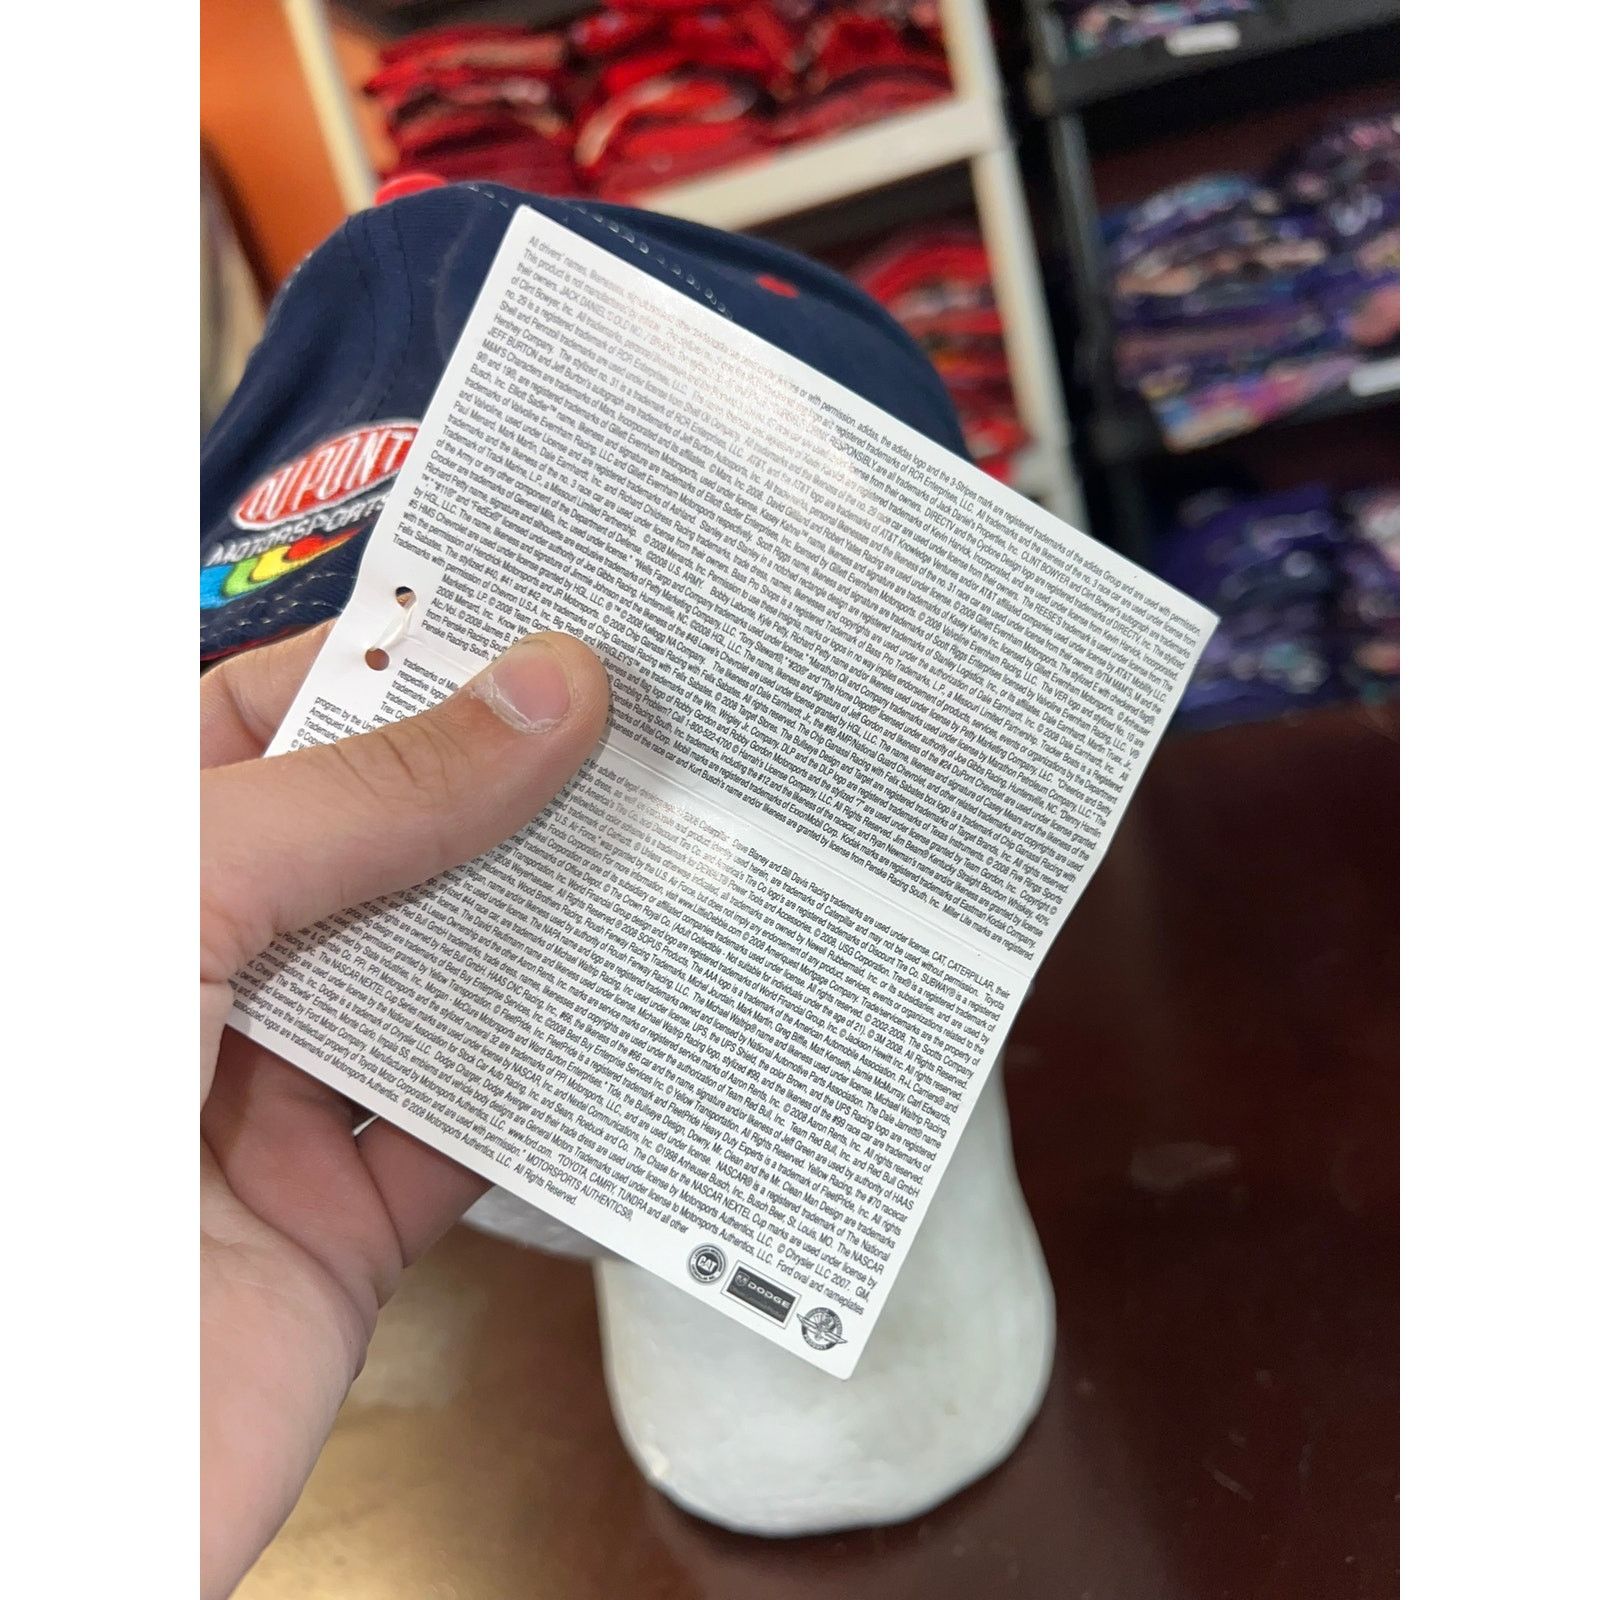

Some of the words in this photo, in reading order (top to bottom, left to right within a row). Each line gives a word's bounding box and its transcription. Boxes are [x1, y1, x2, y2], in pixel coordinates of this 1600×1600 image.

[486, 325, 508, 341] JEFF
[505, 334, 539, 359] BURTON
[536, 353, 553, 367] and
[549, 360, 566, 374] Jeff
[563, 366, 592, 389] Burton's
[590, 383, 625, 407] autograph
[623, 401, 637, 414] are
[635, 406, 673, 434] trademarks
[671, 428, 682, 438] of
[442, 423, 478, 451] Trademark
[476, 444, 487, 455] of
[485, 446, 504, 465] Track
[542, 480, 550, 490] a
[548, 481, 578, 504] Missouri
[575, 496, 602, 517] Limited
[407, 498, 419, 509] #5
[417, 501, 437, 518] HMS
[434, 511, 469, 535] Chevrolet
[466, 529, 480, 541] are
[478, 535, 498, 550] used
[495, 544, 516, 559] under
[392, 532, 431, 560] Trademarks
[430, 554, 446, 567] with
[444, 562, 482, 586] permission
[480, 580, 492, 589] of
[489, 582, 518, 604] Chevron
[1081, 559, 1104, 577] adidas
[1102, 569, 1122, 588] Group
[1120, 582, 1135, 595] and
[1131, 589, 1144, 601] are
[1142, 596, 1160, 610] used
[1157, 604, 1171, 617] with
[425, 607, 442, 623] from
[440, 615, 467, 635] Penske
[465, 627, 490, 648] Racing
[494, 599, 514, 615] 2008
[512, 607, 532, 625] Team
[1020, 549, 1042, 568] CLINT
[1039, 561, 1071, 586] BOWYER
[1067, 580, 1083, 593] and
[1079, 586, 1096, 601] Clint
[1093, 593, 1121, 617] Bowyer's
[1119, 611, 1150, 634] autograph
[1147, 629, 1160, 640] are
[1158, 633, 1191, 659] trademarks
[420, 618, 446, 639] Penske
[444, 630, 470, 652] Racing
[612, 677, 643, 702] Gambling
[641, 693, 673, 717] Problem?
[670, 710, 686, 724] Call
[684, 718, 733, 750] 1-800-522-4700
[737, 747, 765, 768] Harrah's
[762, 761, 789, 781] License
[921, 720, 941, 735] used
[937, 729, 959, 745] under
[955, 737, 980, 757] license
[977, 749, 988, 762] by
[985, 754, 1018, 778] Marathon
[1015, 770, 1049, 795] Petroleum
[937, 757, 953, 771] #24
[949, 763, 976, 784] DuPont
[973, 777, 1006, 801] Chevrolet
[1002, 795, 1016, 806] are
[1014, 801, 1034, 815] used
[1030, 809, 1051, 825] under
[1048, 818, 1073, 838] license
[1069, 832, 1097, 850] granted
[849, 850, 865, 866] from
[863, 859, 888, 879] Penske
[885, 871, 910, 892] Racing
[941, 902, 961, 919] Miller
[958, 912, 973, 926] Lite
[970, 921, 992, 937] marks
[989, 932, 1003, 943] are
[1000, 938, 1035, 961] registered
[891, 833, 906, 846] Jim
[927, 852, 957, 875] Kentucky
[955, 867, 982, 888] Straight
[979, 881, 1007, 902] Bourbon
[1034, 912, 1050, 927] 40%
[425, 904, 447, 922] Lease
[445, 915, 479, 941] Ownership
[476, 934, 493, 947] and
[664, 889, 679, 902] visit
[676, 896, 742, 937] www.LittleDebbie.com
[954, 990, 962, 1002] is
[960, 996, 968, 1005] a
[967, 999, 1001, 1022] registered
[994, 985, 1011, 999] their
[851, 1065, 873, 1083] Jamie
[906, 1093, 923, 1108] Carl
[406, 1101, 427, 1118] 2008
[423, 1110, 463, 1139] Motorsports
[512, 1162, 525, 1175] All
[521, 1166, 545, 1187] Rights
[524, 1151, 582, 1190] MOTORSPORTS
[789, 1120, 808, 1138] Team
[807, 1131, 824, 1147] Red
[851, 1156, 868, 1170] and
[865, 1162, 883, 1178] Red
[880, 1170, 897, 1186] Bull
[895, 1178, 921, 1198] GmbH
[616, 1186, 648, 1212] TUNDRA
[645, 1205, 663, 1219] and
[659, 1213, 672, 1224] all
[668, 1218, 689, 1234] other
[745, 1192, 769, 1212] Busch
[836, 1240, 851, 1257] The
[849, 1249, 885, 1275] NASCAR
[697, 1255, 718, 1273] CAT
[747, 1280, 792, 1309] DODGE
